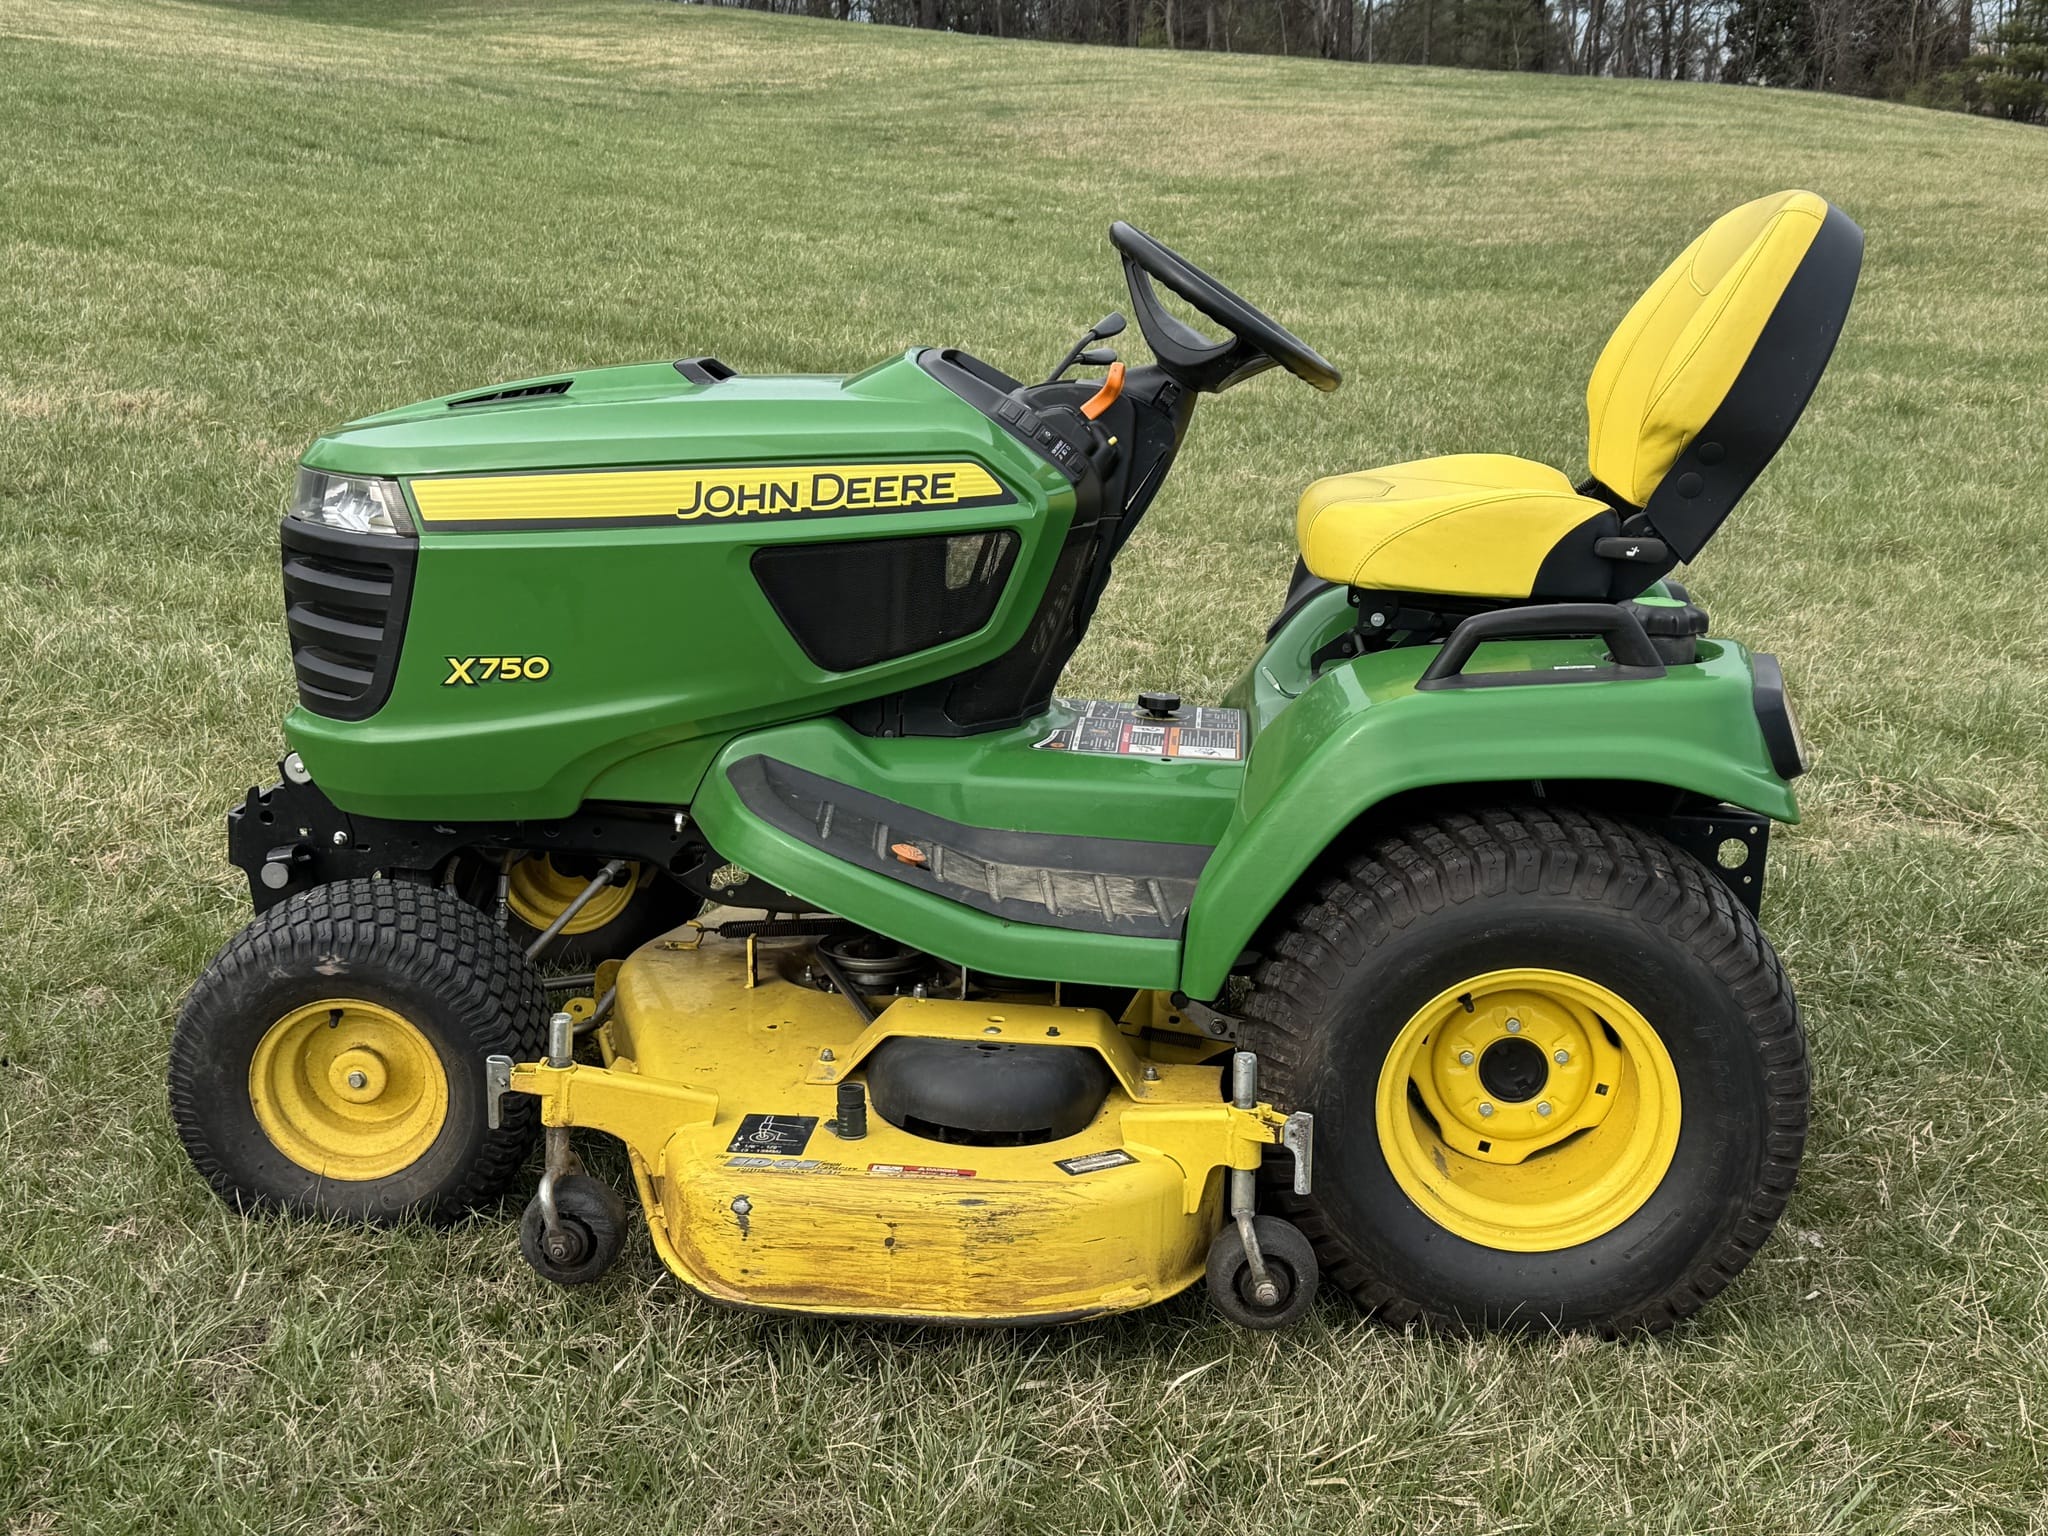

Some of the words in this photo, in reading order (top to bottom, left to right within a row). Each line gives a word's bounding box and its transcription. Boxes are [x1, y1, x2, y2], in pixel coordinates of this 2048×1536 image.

[677, 481, 799, 515] JOHN
[811, 472, 956, 507] DEERE
[443, 656, 550, 685] X750
